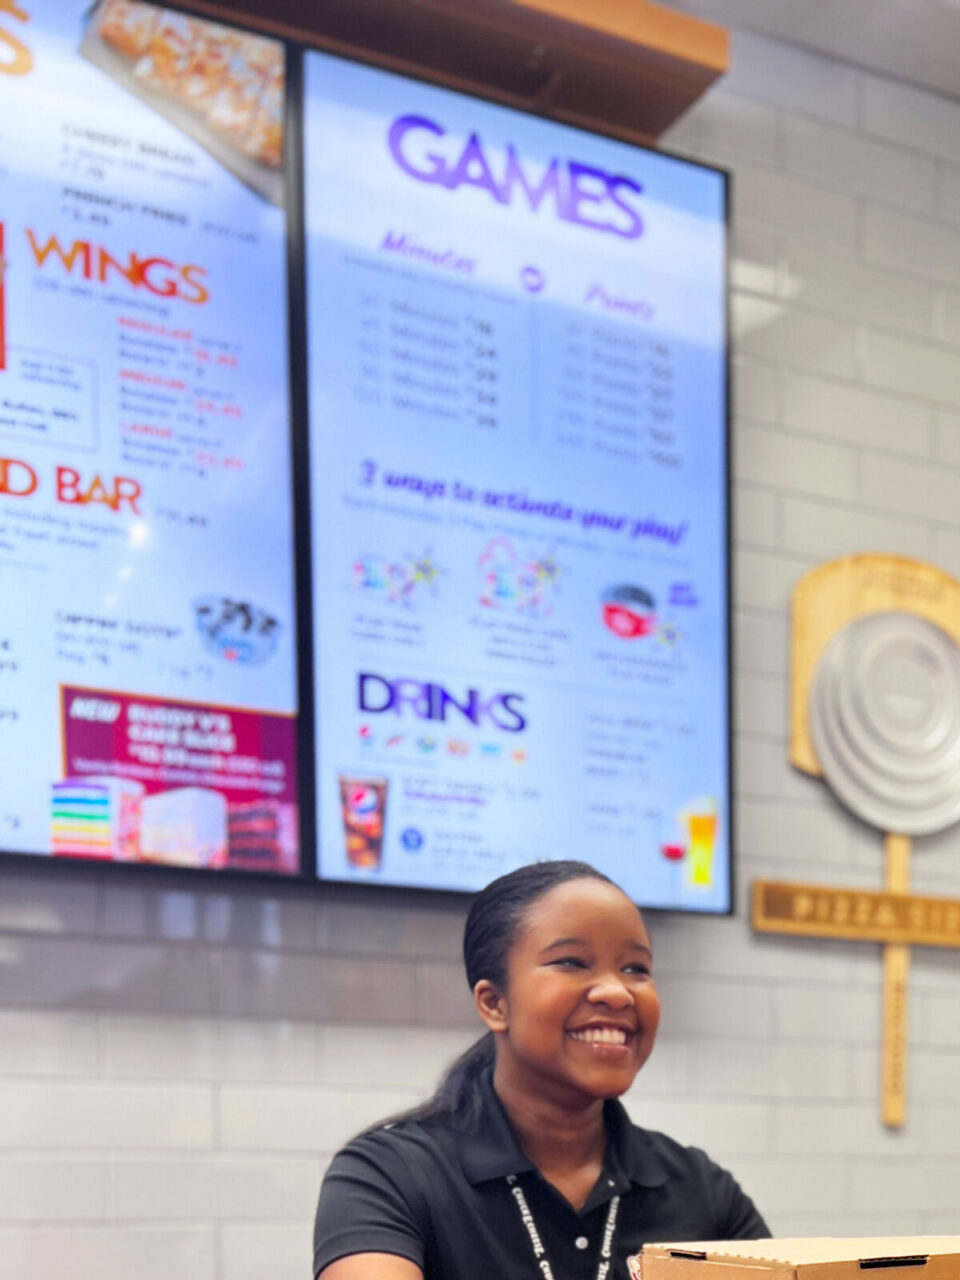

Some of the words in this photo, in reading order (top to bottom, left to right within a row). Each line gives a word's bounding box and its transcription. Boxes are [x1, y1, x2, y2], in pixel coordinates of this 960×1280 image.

[388, 112, 646, 240] GAMES
[25, 228, 210, 305] WINGS
[55, 465, 143, 516] BAR
[358, 672, 527, 733] DRINKS
